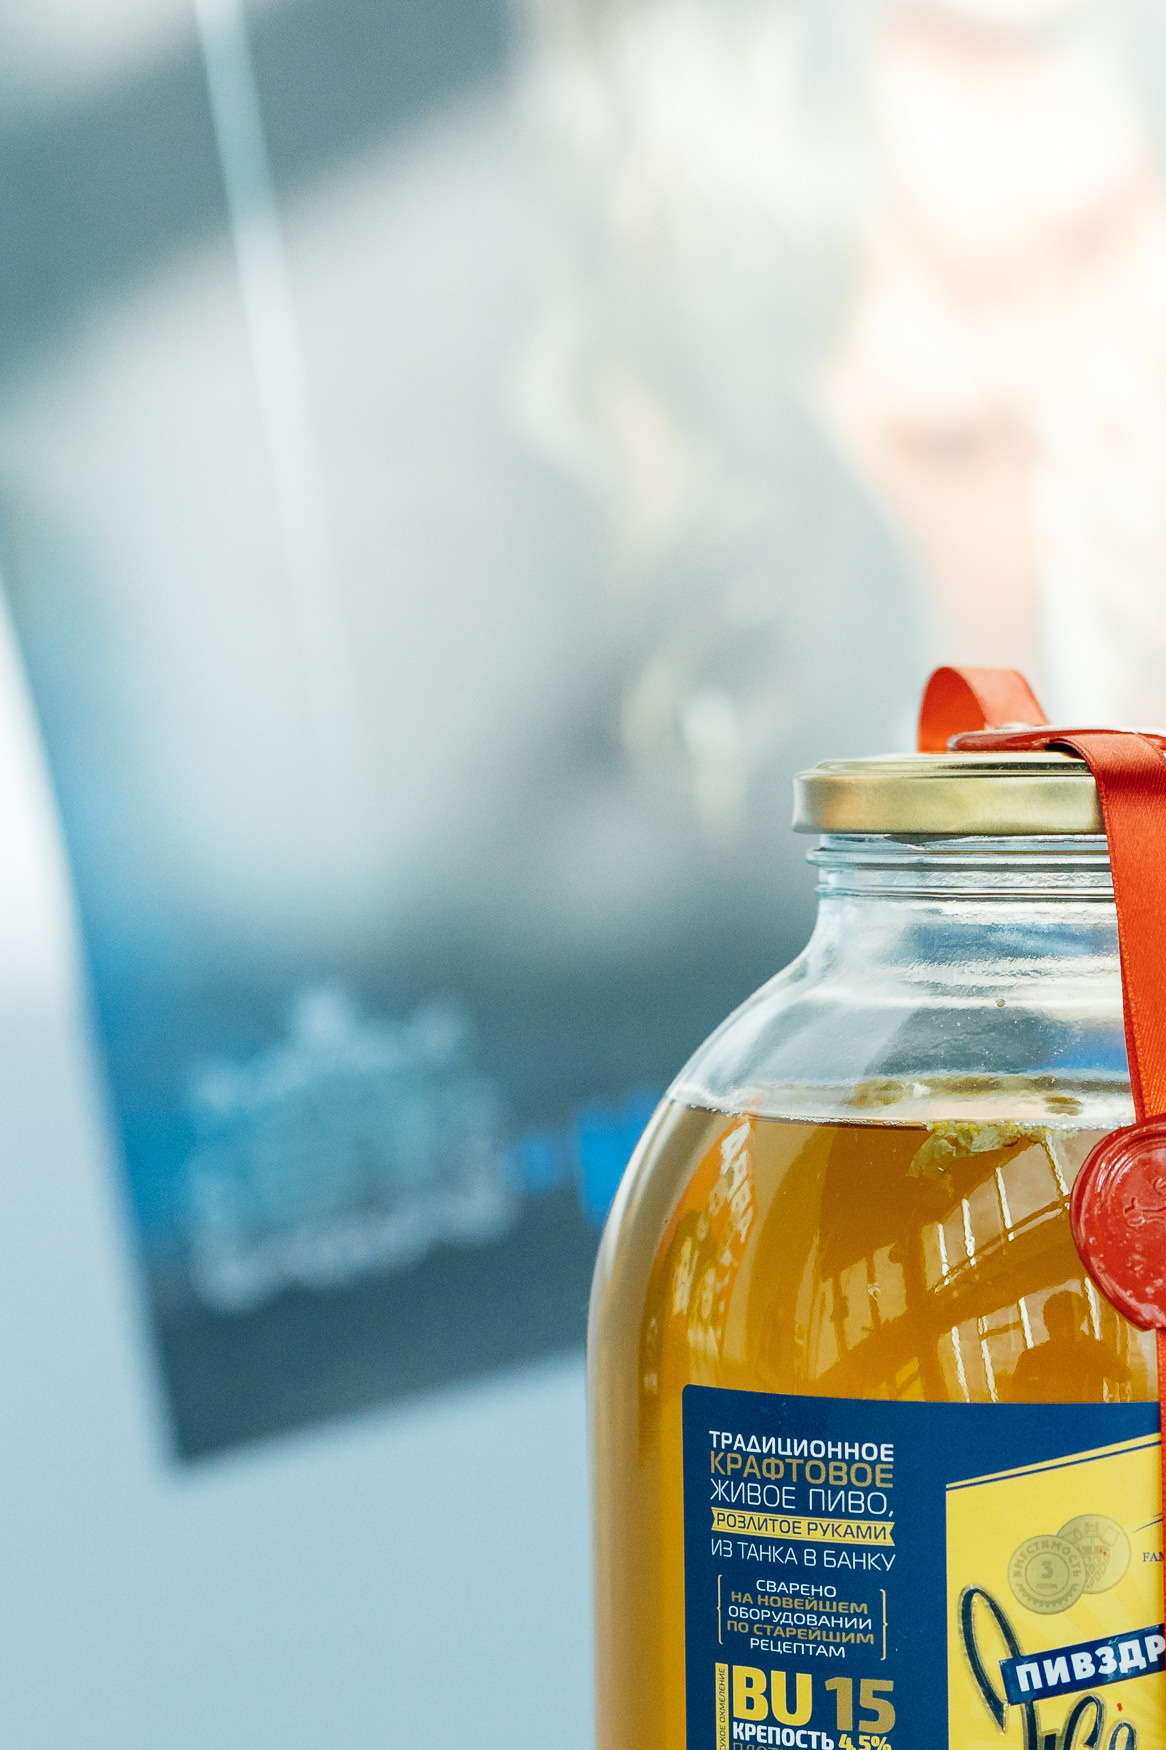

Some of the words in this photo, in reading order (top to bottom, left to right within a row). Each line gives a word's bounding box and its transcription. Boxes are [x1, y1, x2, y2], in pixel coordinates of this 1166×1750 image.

[709, 1430, 894, 1462] ТРАДИЦИОННОЕ
[711, 1450, 893, 1488] КРАФТОВОЕ
[710, 1478, 796, 1509] ЖИВОЕ
[809, 1488, 894, 1517] ПИВО,
[716, 1512, 802, 1535] РОЗЛИТОЕ
[807, 1522, 887, 1541] РУКАМИ
[711, 1538, 733, 1558] ИЗ
[737, 1541, 798, 1565] ТАНКА
[804, 1548, 816, 1566] В
[823, 1550, 896, 1571] БАНКУ
[1012, 1538, 1080, 1578] ВМЕСТИМОСТЬ
[1040, 1560, 1054, 1579] 3
[731, 1591, 753, 1603] НА
[757, 1593, 868, 1614] НОВЕЙШЕМ
[756, 1579, 837, 1597] СВАРЕНО
[728, 1605, 872, 1630] ОБОРУДОВАНИИ
[727, 1620, 749, 1633] ПО
[753, 1624, 875, 1645] СТАРЕЙШИМ
[750, 1638, 845, 1658] РЕЦЕПТАМ
[1015, 1634, 1166, 1693] ПИВЗДР
[825, 1676, 896, 1734] 15
[732, 1721, 834, 1750] КРЕПОСТЬ
